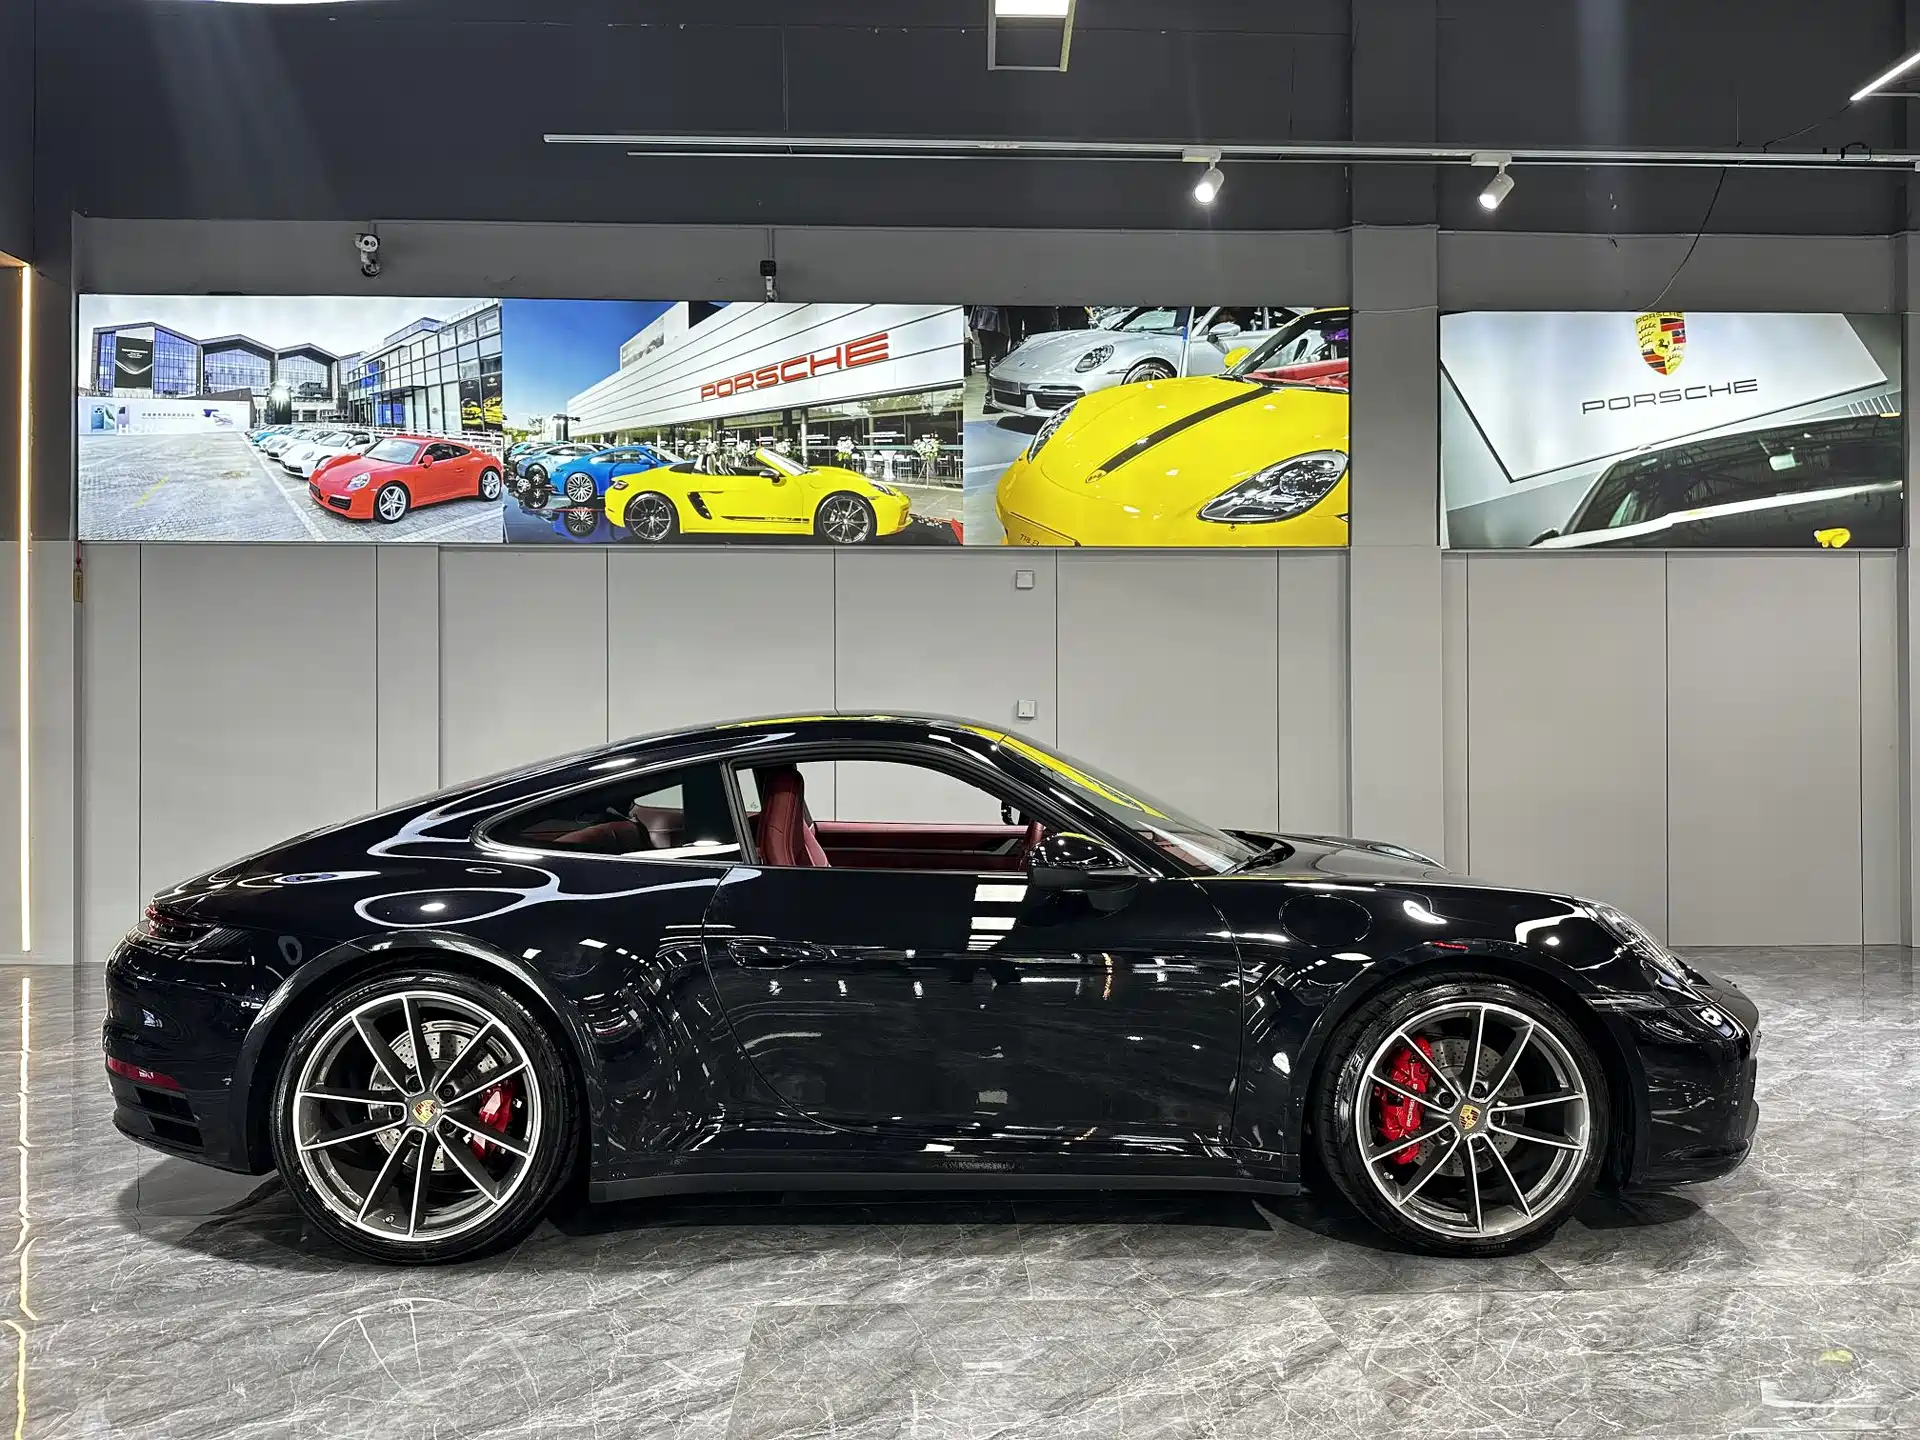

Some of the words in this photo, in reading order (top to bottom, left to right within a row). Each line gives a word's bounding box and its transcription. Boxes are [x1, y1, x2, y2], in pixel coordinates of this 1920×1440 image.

[1636, 312, 1684, 324] PORSCHE
[700, 332, 889, 402] PORSCHE
[1582, 379, 1758, 414] PORSCHE
